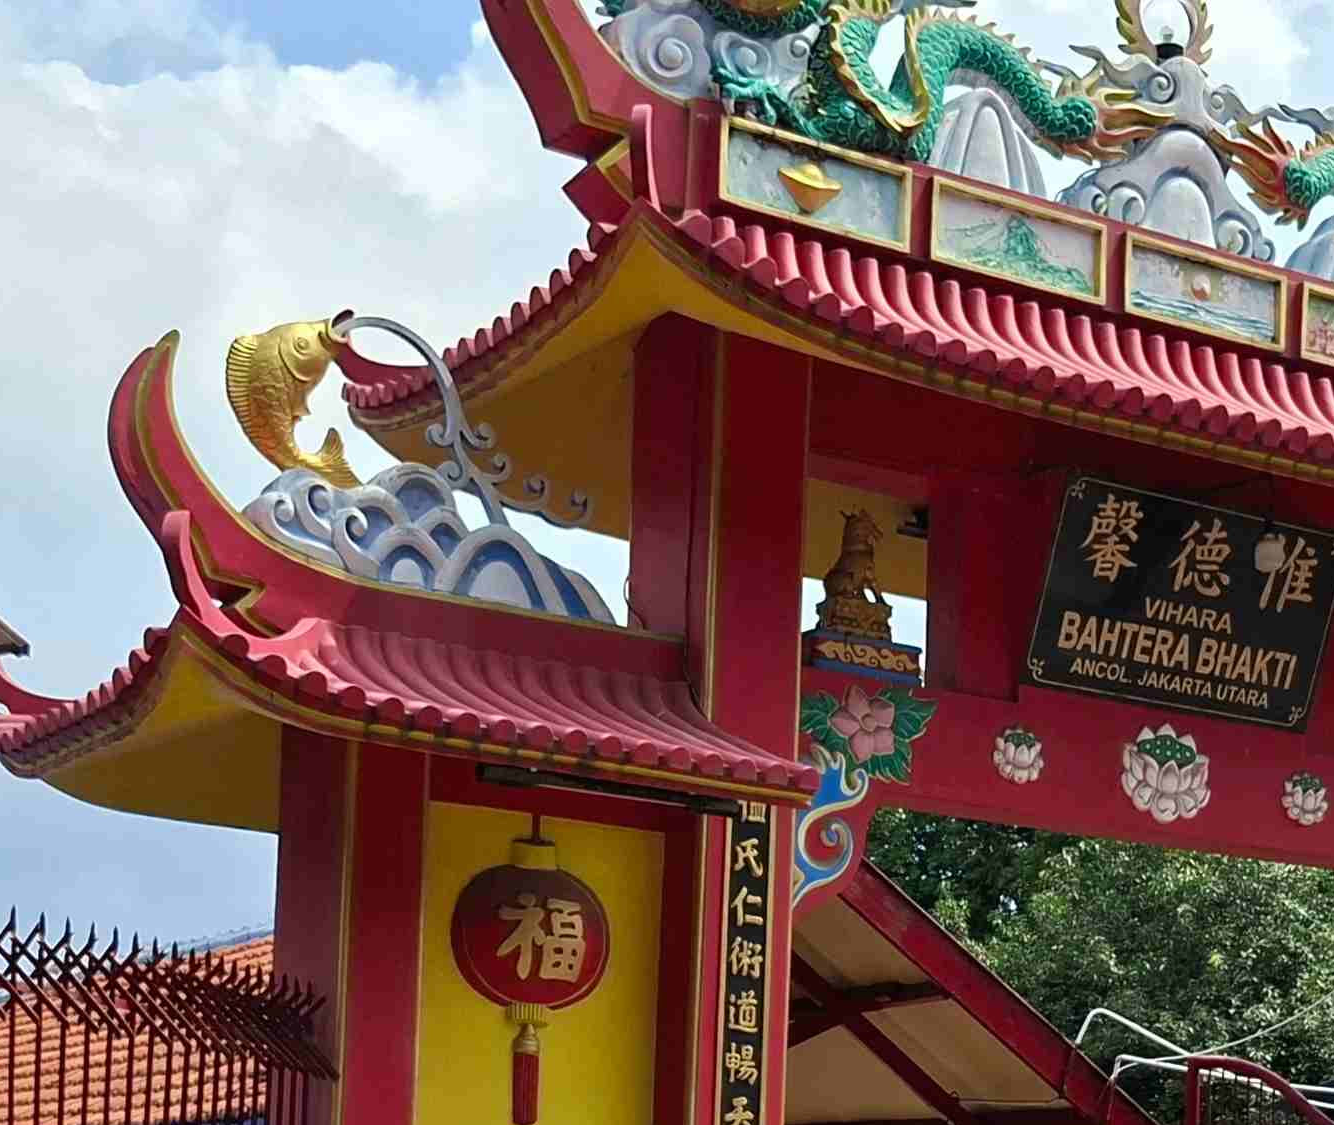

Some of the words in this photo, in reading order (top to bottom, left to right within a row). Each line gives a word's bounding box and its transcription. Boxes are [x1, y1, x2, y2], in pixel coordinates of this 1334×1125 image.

[1144, 596, 1234, 635] VIHARA
[1057, 610, 1191, 671] BAHTERA
[1195, 637, 1299, 690] BHAKTI
[1137, 672, 1213, 700] JAKARTA
[1216, 685, 1270, 709] UTARA
[496, 892, 587, 984] 福
